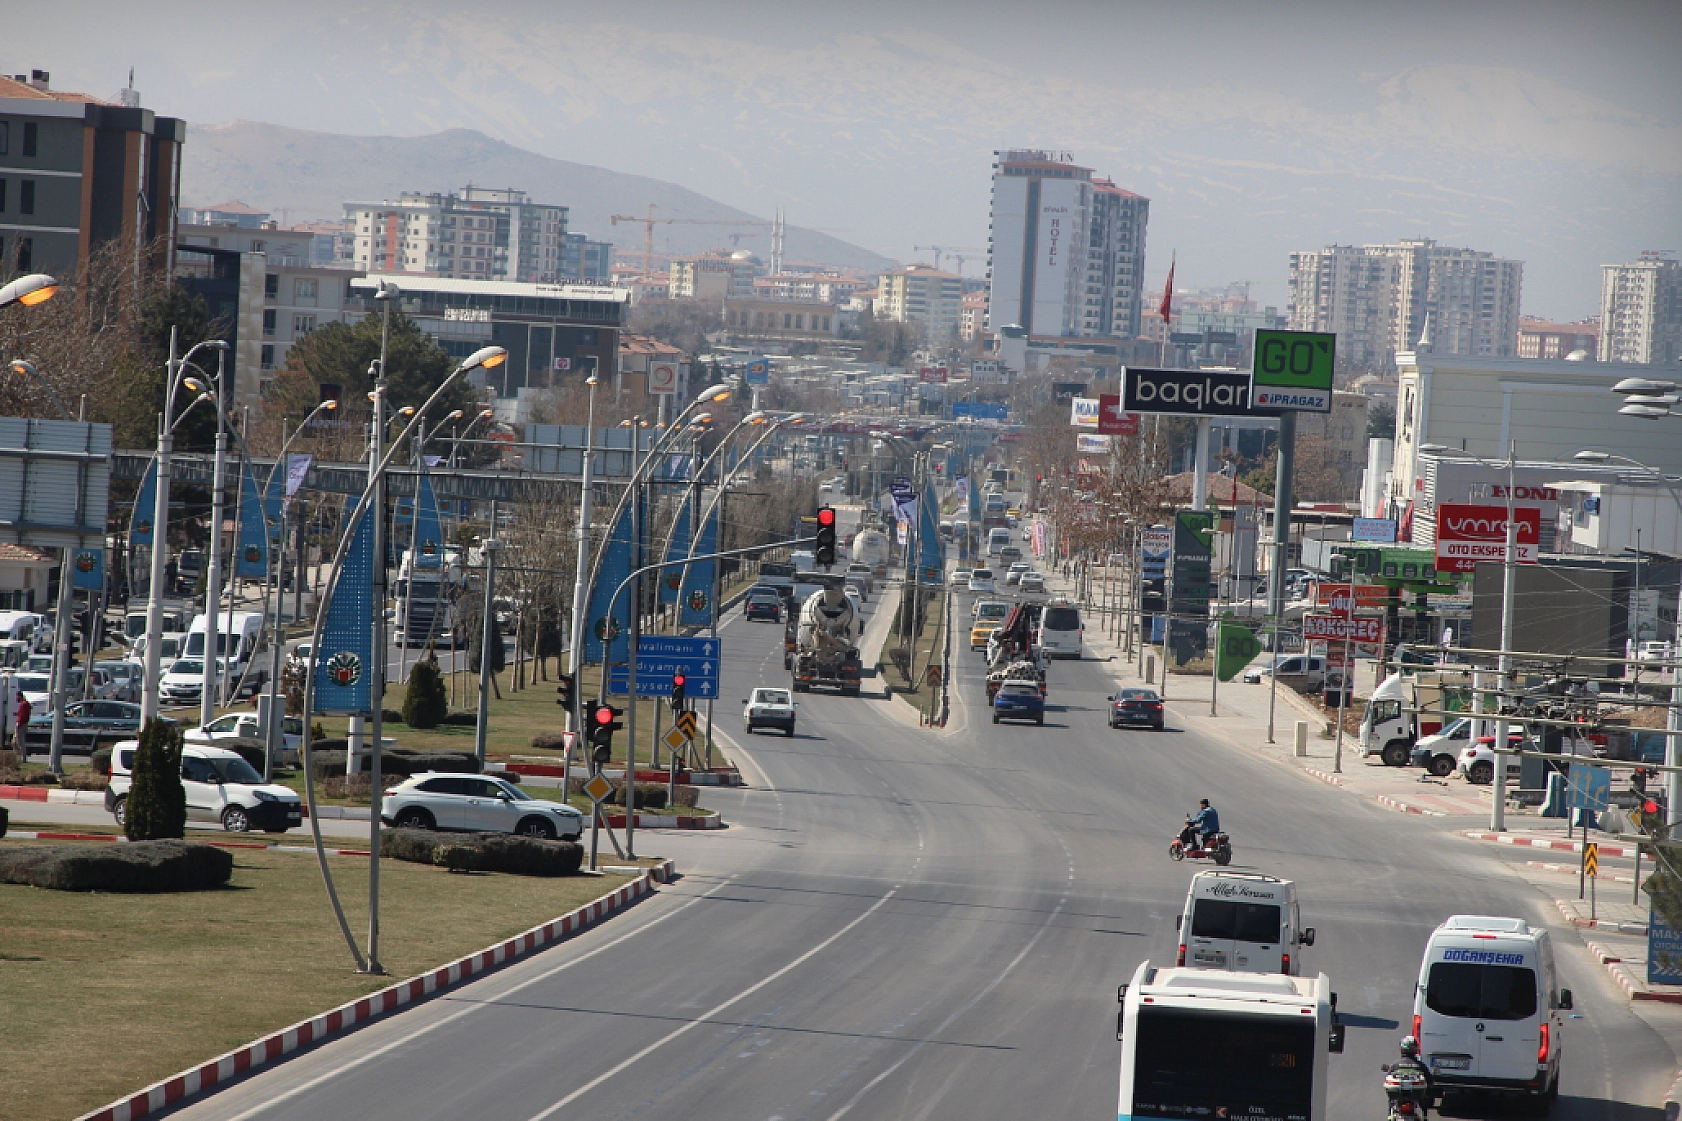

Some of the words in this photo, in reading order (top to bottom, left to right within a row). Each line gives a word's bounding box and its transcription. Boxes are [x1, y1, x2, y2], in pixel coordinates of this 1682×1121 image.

[1048, 218, 1060, 266] HOTEL
[1262, 338, 1314, 374] GO
[1448, 543, 1469, 555] OTO
[1305, 617, 1379, 640] KOKOREÇ
[1226, 637, 1255, 658] GO
